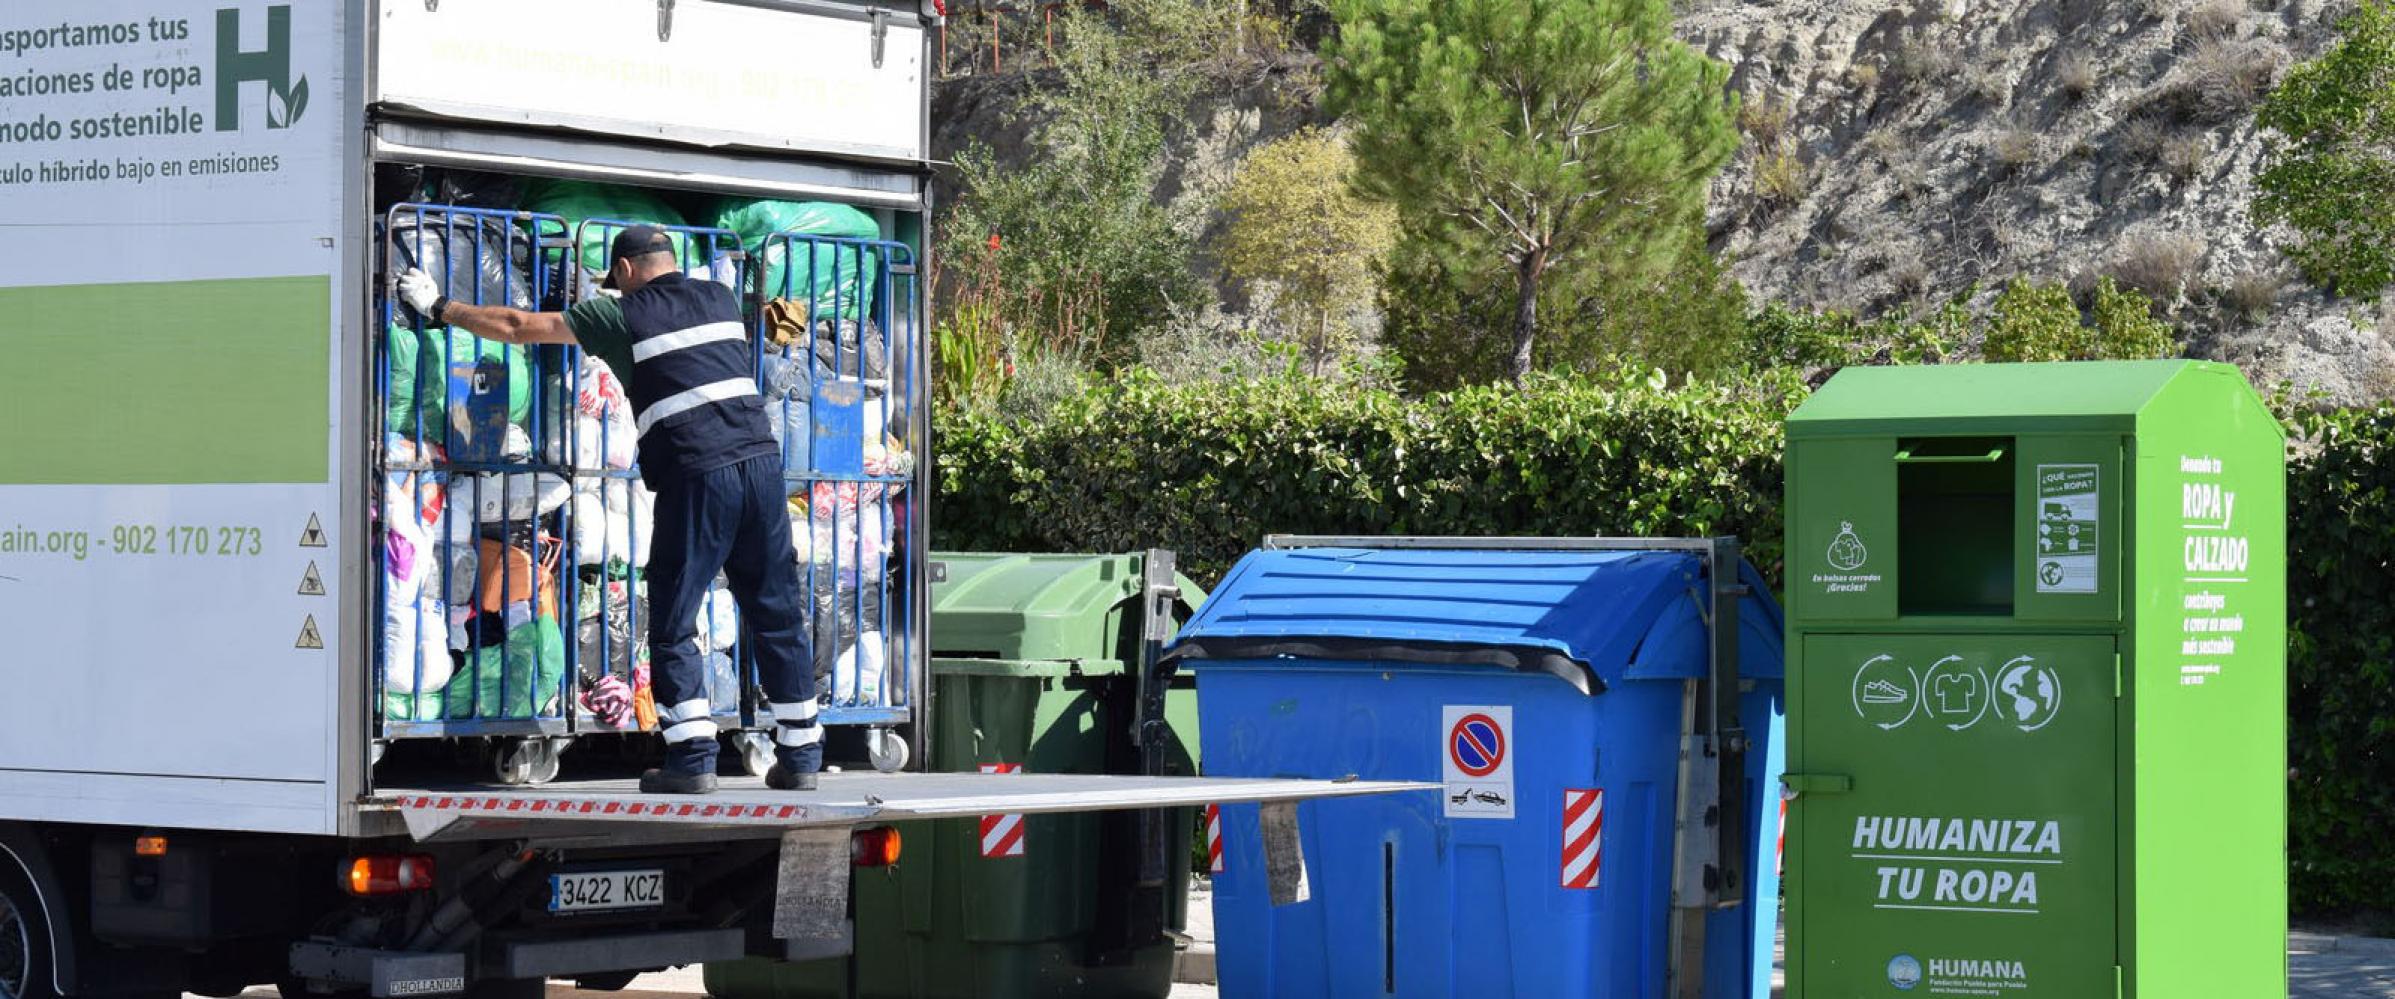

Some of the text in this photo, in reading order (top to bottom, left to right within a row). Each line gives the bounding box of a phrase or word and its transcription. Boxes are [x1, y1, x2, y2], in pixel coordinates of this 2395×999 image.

[0, 16, 189, 57] sportamos tus
[103, 63, 133, 91] de
[143, 65, 201, 95] ropa
[70, 106, 203, 140] sostenible
[0, 152, 279, 184] ulo híbrido bajo en emisiones
[2183, 483, 2235, 530] ROPA y
[2, 523, 87, 561] ain.org
[113, 525, 156, 554] 902
[167, 526, 208, 554] 170
[217, 527, 262, 555] 273
[2184, 536, 2249, 571] CALZADO
[1852, 816, 2061, 854] HUMANIZA
[563, 875, 660, 906] 3422 KCZ
[1876, 867, 2038, 904] TU ROPA
[1929, 958, 2026, 979] HUMANA
[391, 978, 464, 995] DHOLLANDIA
